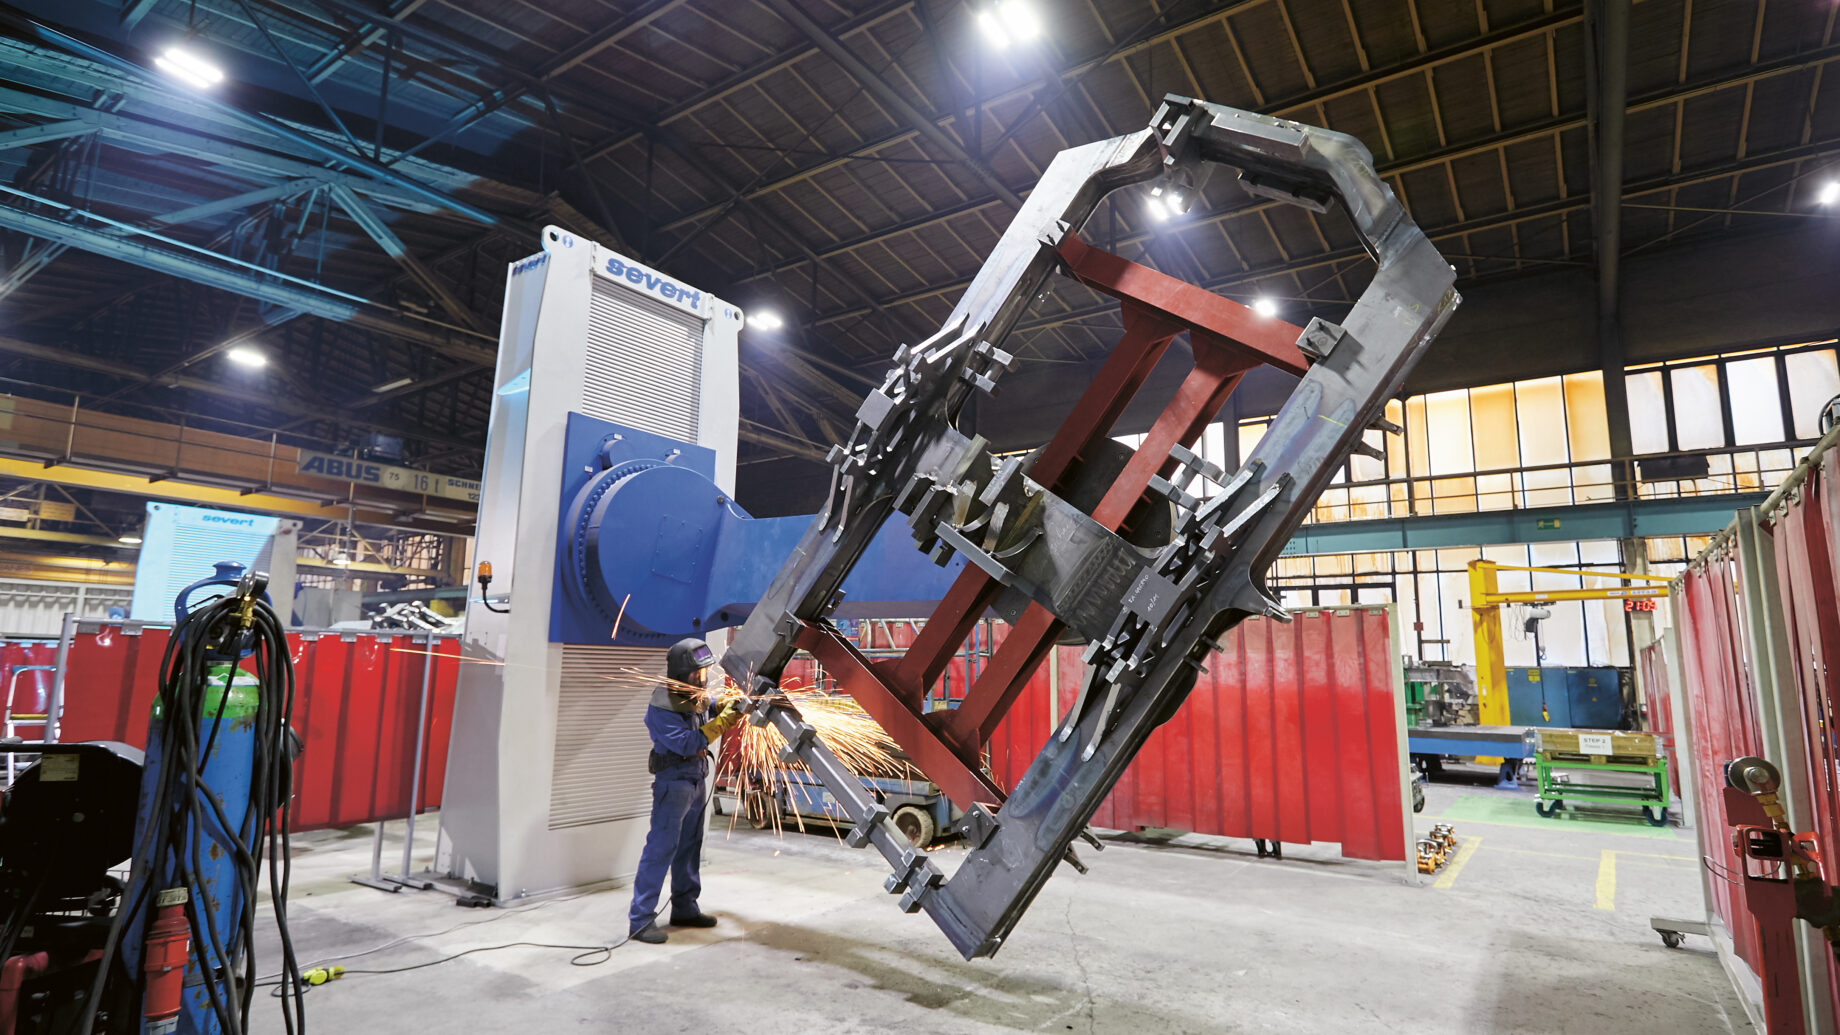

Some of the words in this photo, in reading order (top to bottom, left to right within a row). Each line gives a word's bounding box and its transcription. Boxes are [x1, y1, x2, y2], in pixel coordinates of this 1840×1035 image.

[606, 257, 701, 310] severt
[301, 456, 381, 483] ABUS
[388, 471, 400, 481] 75
[413, 473, 429, 492] 16
[202, 514, 255, 527] severt
[1624, 599, 1657, 612] 21:09
